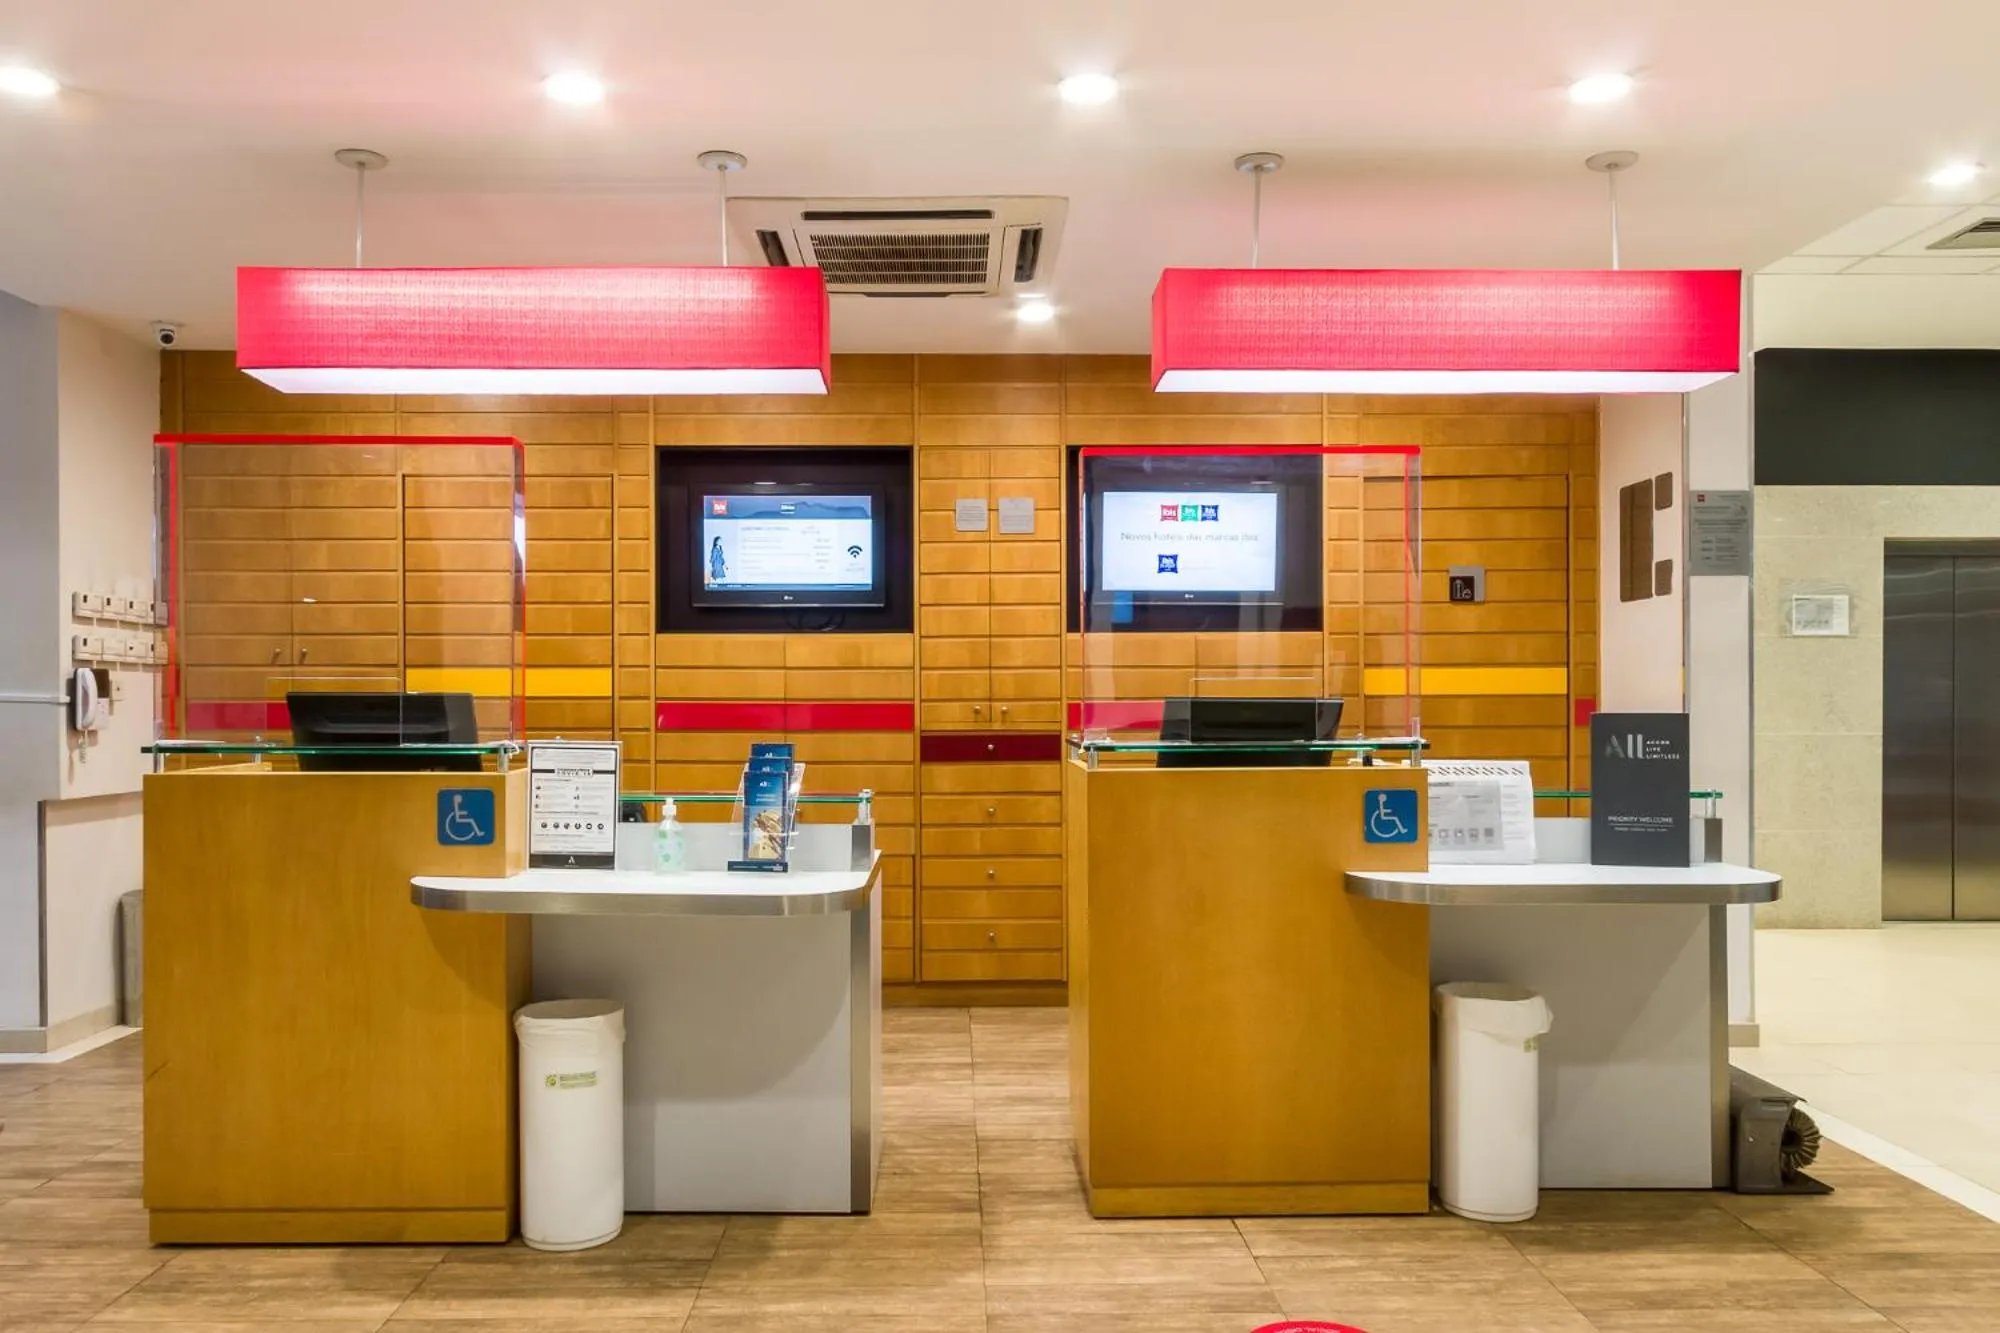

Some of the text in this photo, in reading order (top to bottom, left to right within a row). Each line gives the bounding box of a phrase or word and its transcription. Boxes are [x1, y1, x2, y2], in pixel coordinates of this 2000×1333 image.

[1120, 532, 1151, 542] Novos
[1205, 534, 1238, 542] marcas
[1638, 816, 1673, 824] WELCOME
